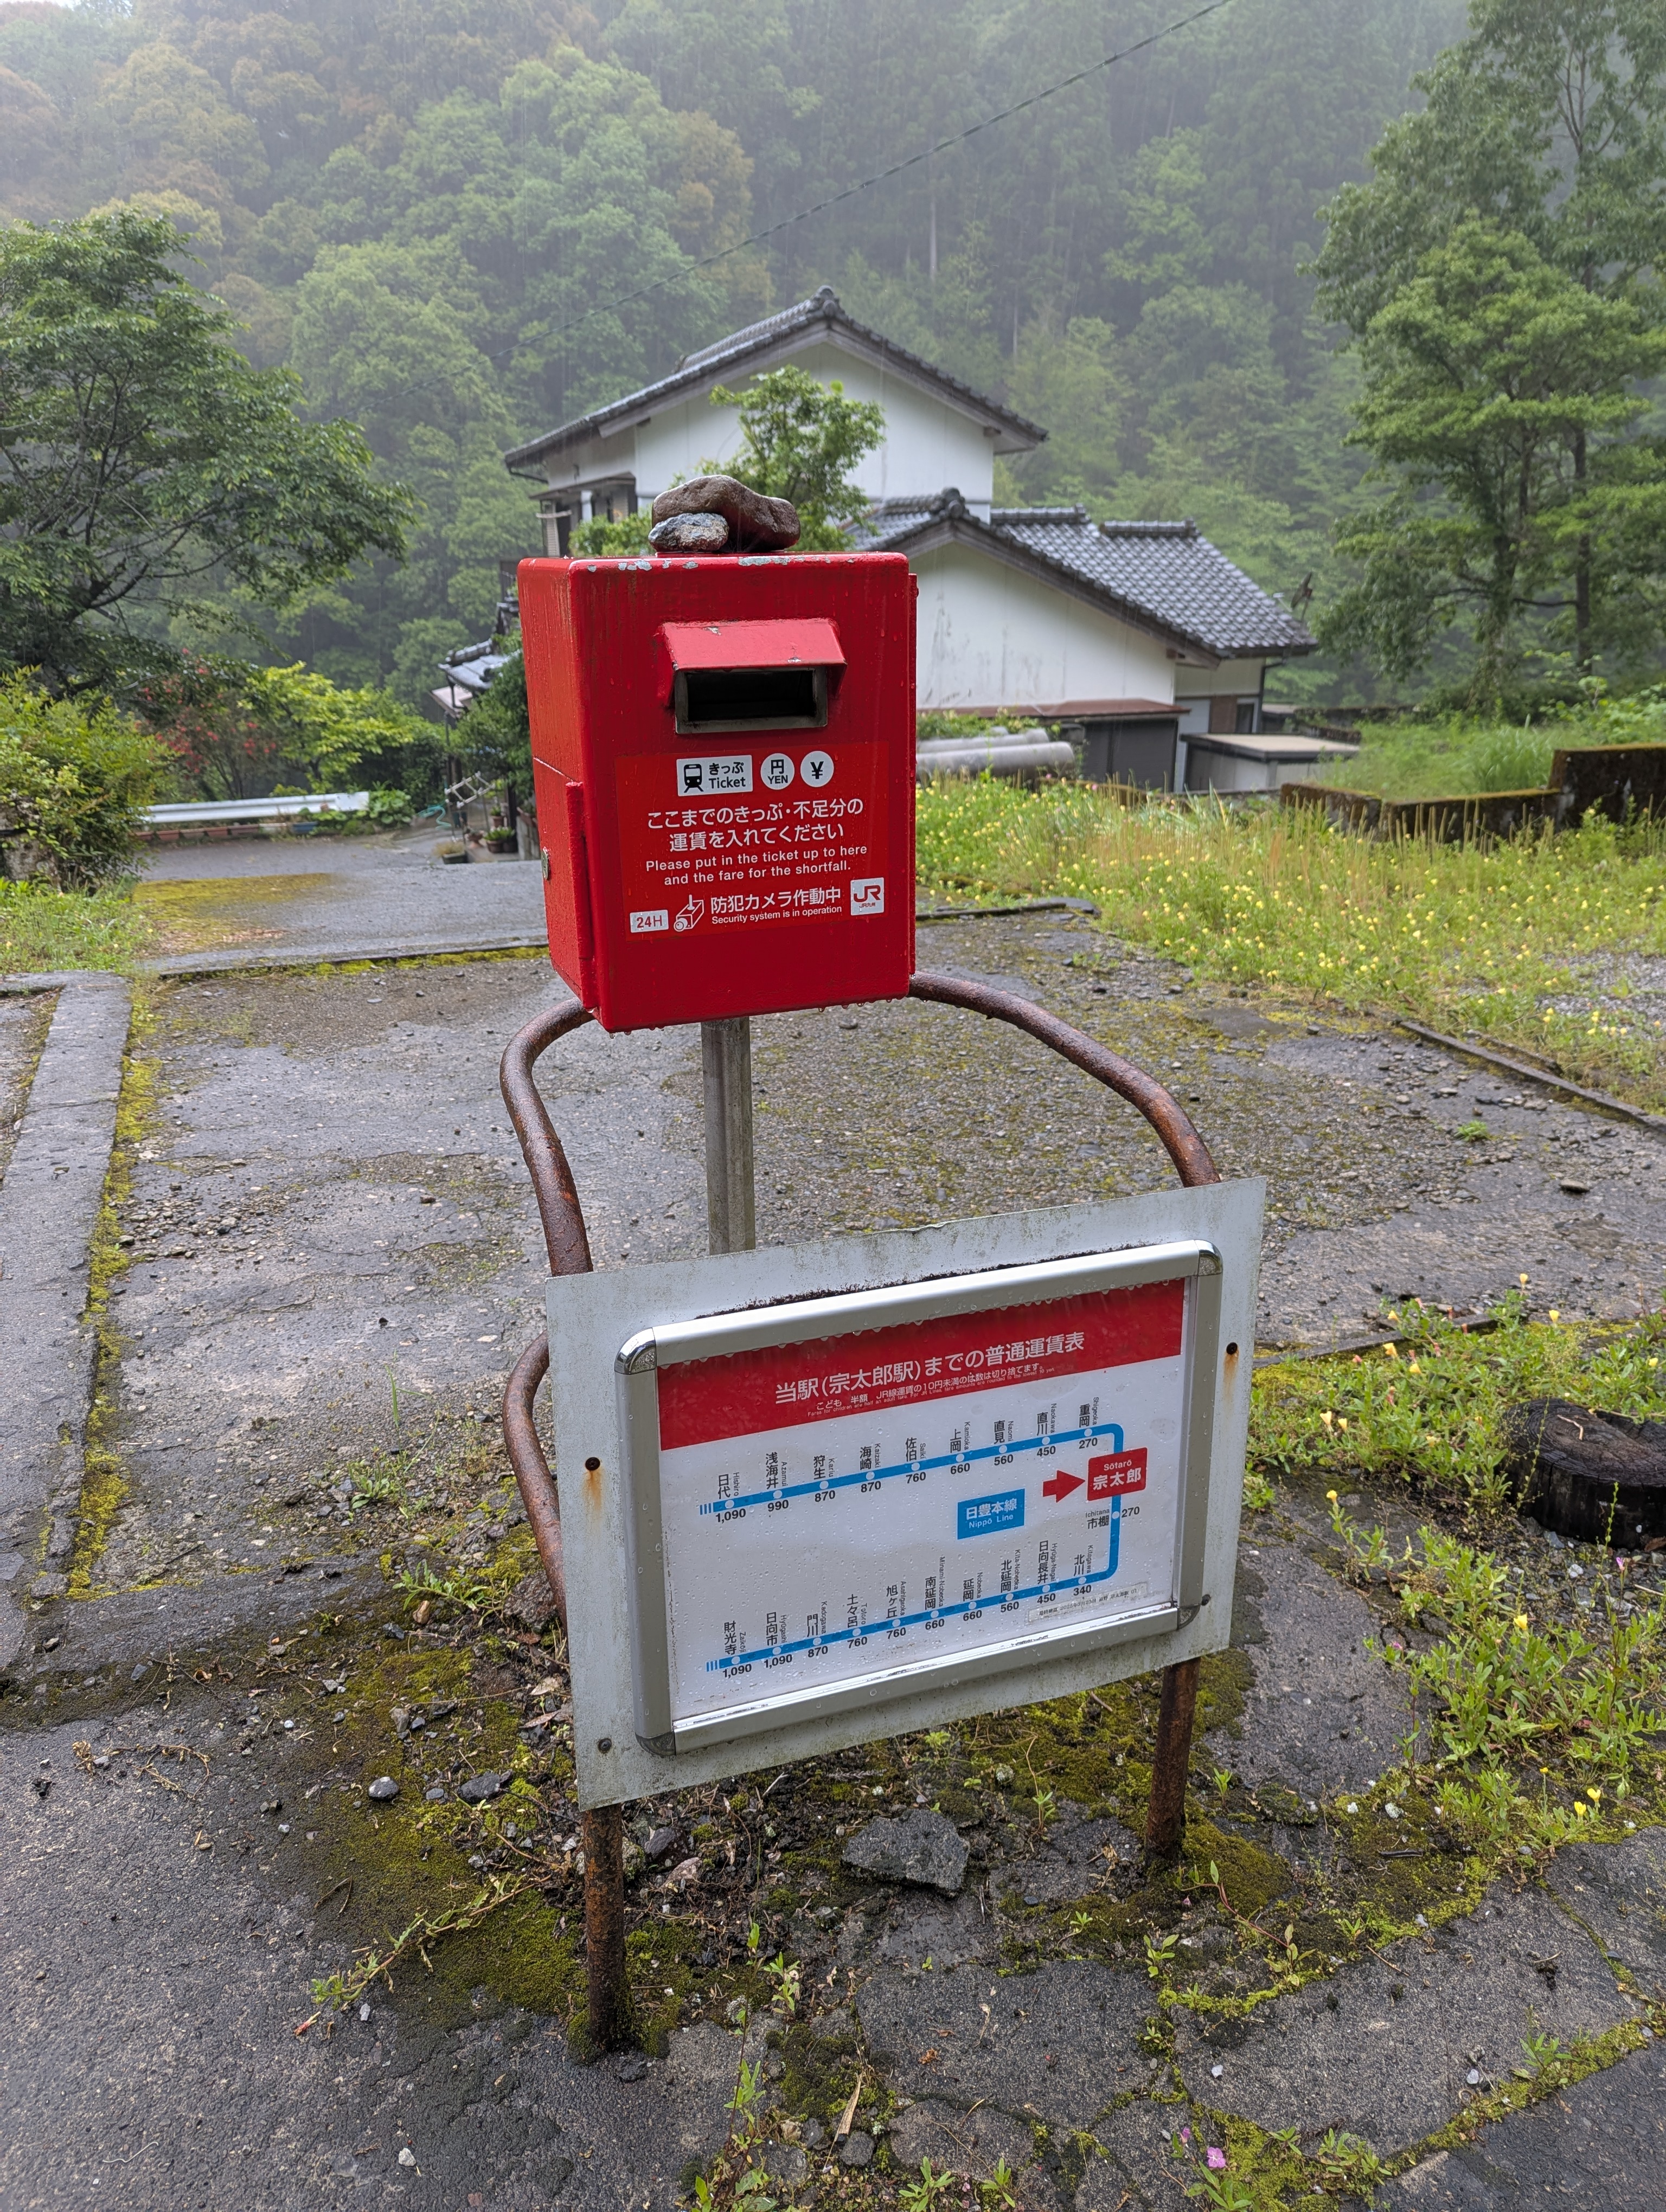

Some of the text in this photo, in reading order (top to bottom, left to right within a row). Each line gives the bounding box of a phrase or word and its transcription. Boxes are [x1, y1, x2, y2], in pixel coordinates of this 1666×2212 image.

[708, 762, 744, 775] きっぷ
[771, 759, 784, 775] 円
[810, 761, 824, 780] ¥
[708, 776, 746, 789] Ticket
[767, 774, 788, 785] YEN
[648, 798, 863, 829] ここまでのきっぷ・不足分の
[669, 824, 844, 853] 運賃を入れてください
[646, 844, 867, 872] Please put in the ticket up to here
[664, 860, 851, 886] and the fare for the shortfall.
[710, 886, 841, 915] 防犯カメラ作動中
[854, 885, 881, 902] JR
[636, 915, 663, 929] 24H
[712, 905, 842, 924] Security system is in operation
[776, 1332, 1084, 1404] 当駅(宗太郎駅)までの普通運賃表
[817, 1398, 842, 1410] こども
[850, 1393, 868, 1403] 半額
[1037, 1412, 1048, 1436] 直川
[1079, 1404, 1091, 1427] 重岡
[994, 1420, 1005, 1444] 直見
[905, 1437, 917, 1462] 佐伯
[950, 1429, 962, 1453] 上岡
[1079, 1438, 1098, 1449] 270
[860, 1446, 872, 1470] 海崎
[994, 1454, 1013, 1465] 560
[1037, 1446, 1056, 1457] 450
[765, 1451, 779, 1489] 浅海井
[813, 1455, 825, 1480] 狩生
[950, 1463, 970, 1474] 660
[906, 1471, 926, 1483] 760
[1093, 1467, 1142, 1490] 宗太郎
[717, 1474, 731, 1499] 日代
[861, 1481, 881, 1493] 870
[815, 1490, 836, 1502] 870
[767, 1500, 789, 1512] 990
[966, 1498, 1017, 1520] 日豊本線
[1086, 1509, 1110, 1517] Ichitana
[1122, 1506, 1140, 1517] 270
[716, 1508, 746, 1523] 1,090
[969, 1513, 1014, 1529] Nippō Line
[1087, 1515, 1109, 1529] 市棚
[1037, 1540, 1049, 1584] 日向長井
[1073, 1554, 1085, 1577] 北川
[1001, 1559, 1012, 1593] 北延岡
[925, 1576, 937, 1610] 南延岡
[963, 1578, 975, 1602] 延岡
[1037, 1593, 1056, 1604] 450
[1073, 1585, 1092, 1596] 340
[847, 1594, 858, 1628] 土々呂
[963, 1610, 982, 1621] 660
[1001, 1601, 1019, 1613] 560
[766, 1612, 778, 1645] 日向市
[807, 1613, 818, 1637] 門川
[925, 1618, 944, 1630] 660
[724, 1621, 737, 1655] 財光寺
[886, 1627, 906, 1639] 760
[847, 1636, 868, 1649] 760
[808, 1646, 828, 1658] 870
[764, 1654, 793, 1669] 1,090
[722, 1664, 752, 1679] 1,090
